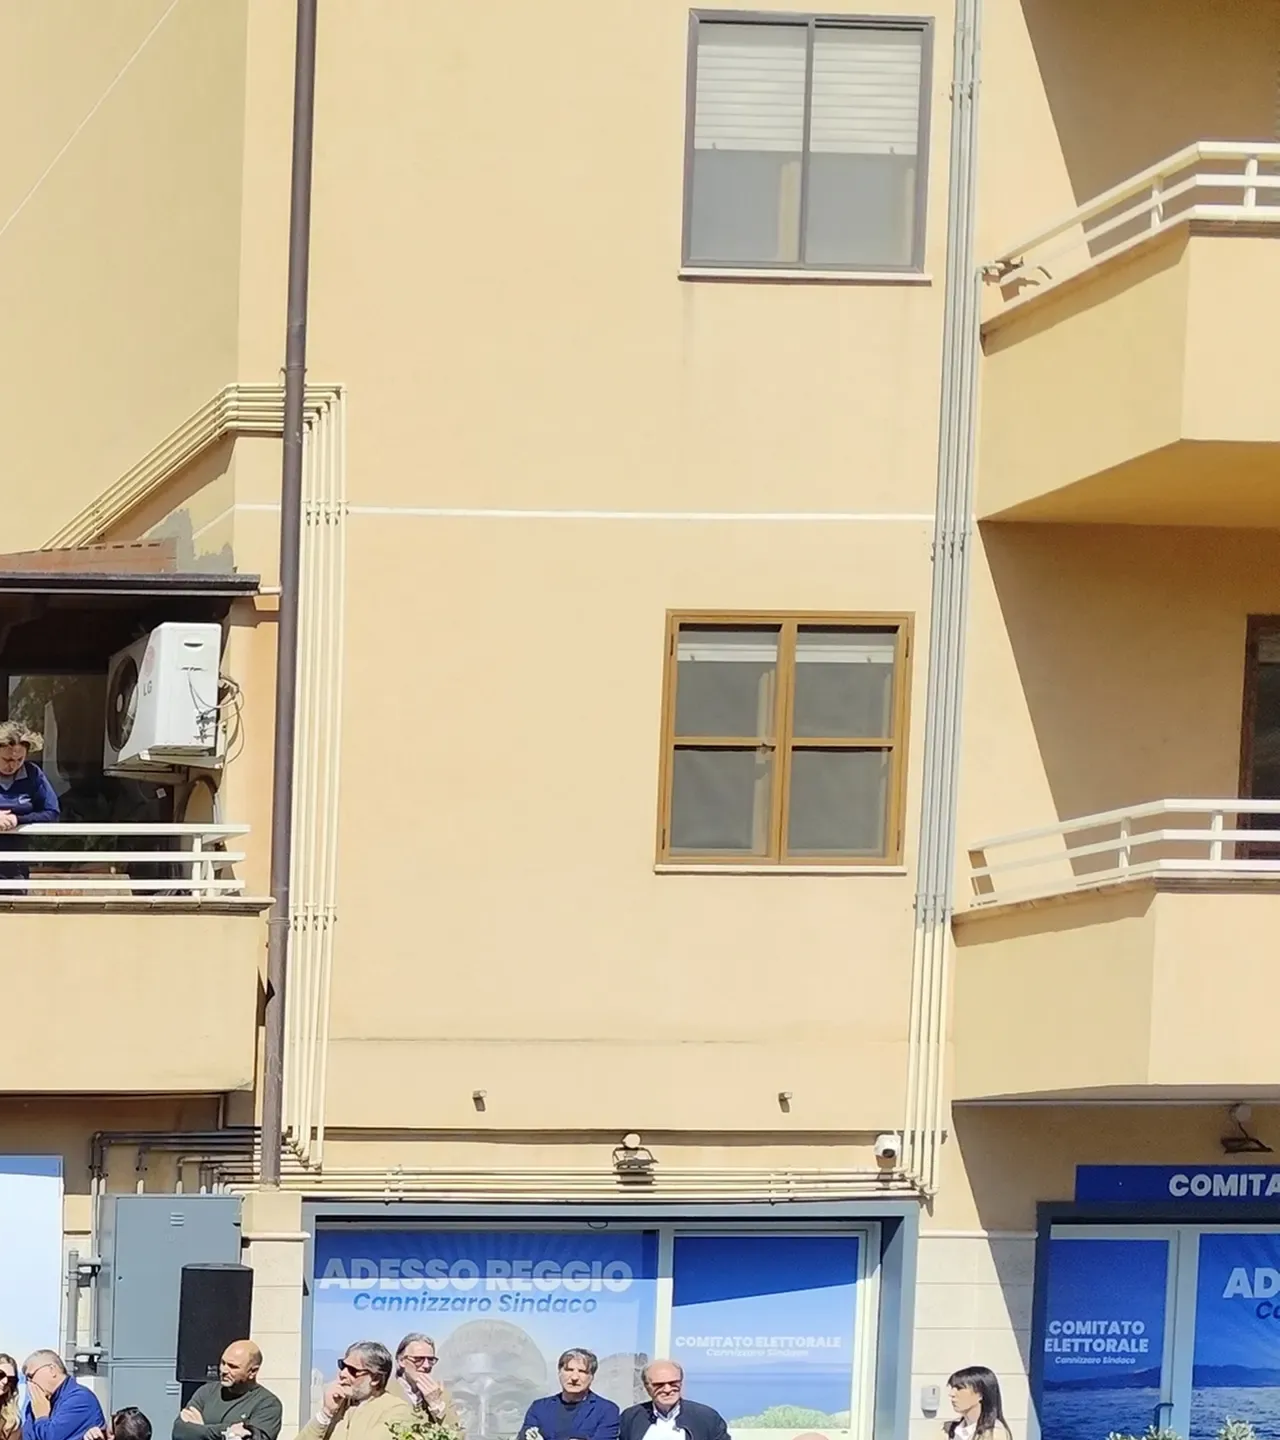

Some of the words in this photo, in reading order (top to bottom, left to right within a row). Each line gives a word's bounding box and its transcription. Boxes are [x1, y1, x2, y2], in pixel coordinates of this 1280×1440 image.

[318, 1257, 480, 1292] ADESSO
[486, 1259, 633, 1293] REGGIO
[353, 1290, 492, 1313] Cannizzaro
[498, 1291, 598, 1315] Sindaco
[1048, 1320, 1145, 1336] COMITATO
[675, 1336, 753, 1348] COMITATO
[755, 1336, 841, 1348] ELETTORALE
[1044, 1338, 1149, 1353] ELETTORALE
